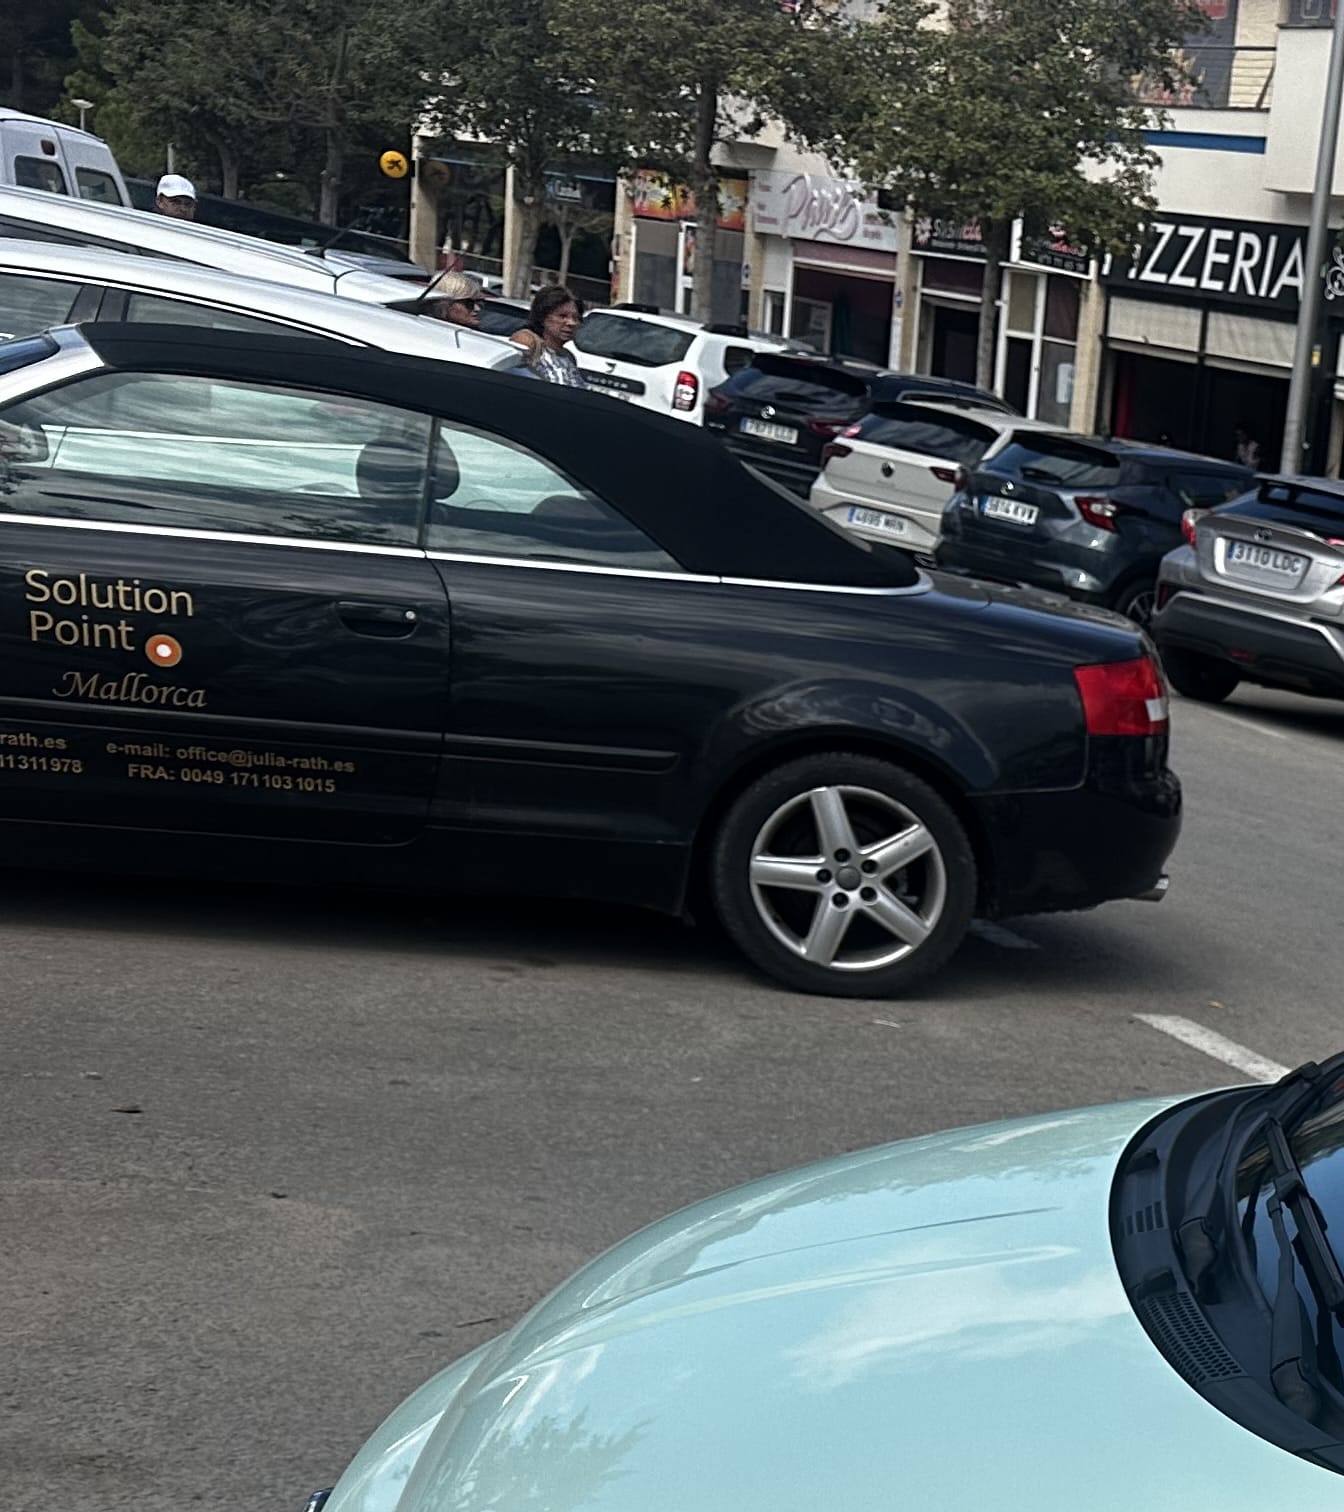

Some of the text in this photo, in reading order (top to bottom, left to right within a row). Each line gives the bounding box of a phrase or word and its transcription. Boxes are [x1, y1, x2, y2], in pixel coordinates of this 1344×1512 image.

[1235, 544, 1271, 566] 3110
[25, 569, 193, 616] Solution
[30, 610, 135, 650] Point
[52, 671, 207, 708] Mallorca
[106, 742, 355, 773] e-mail: office@julia-rath.es
[128, 763, 176, 780] FRA:
[180, 768, 224, 784] 0049
